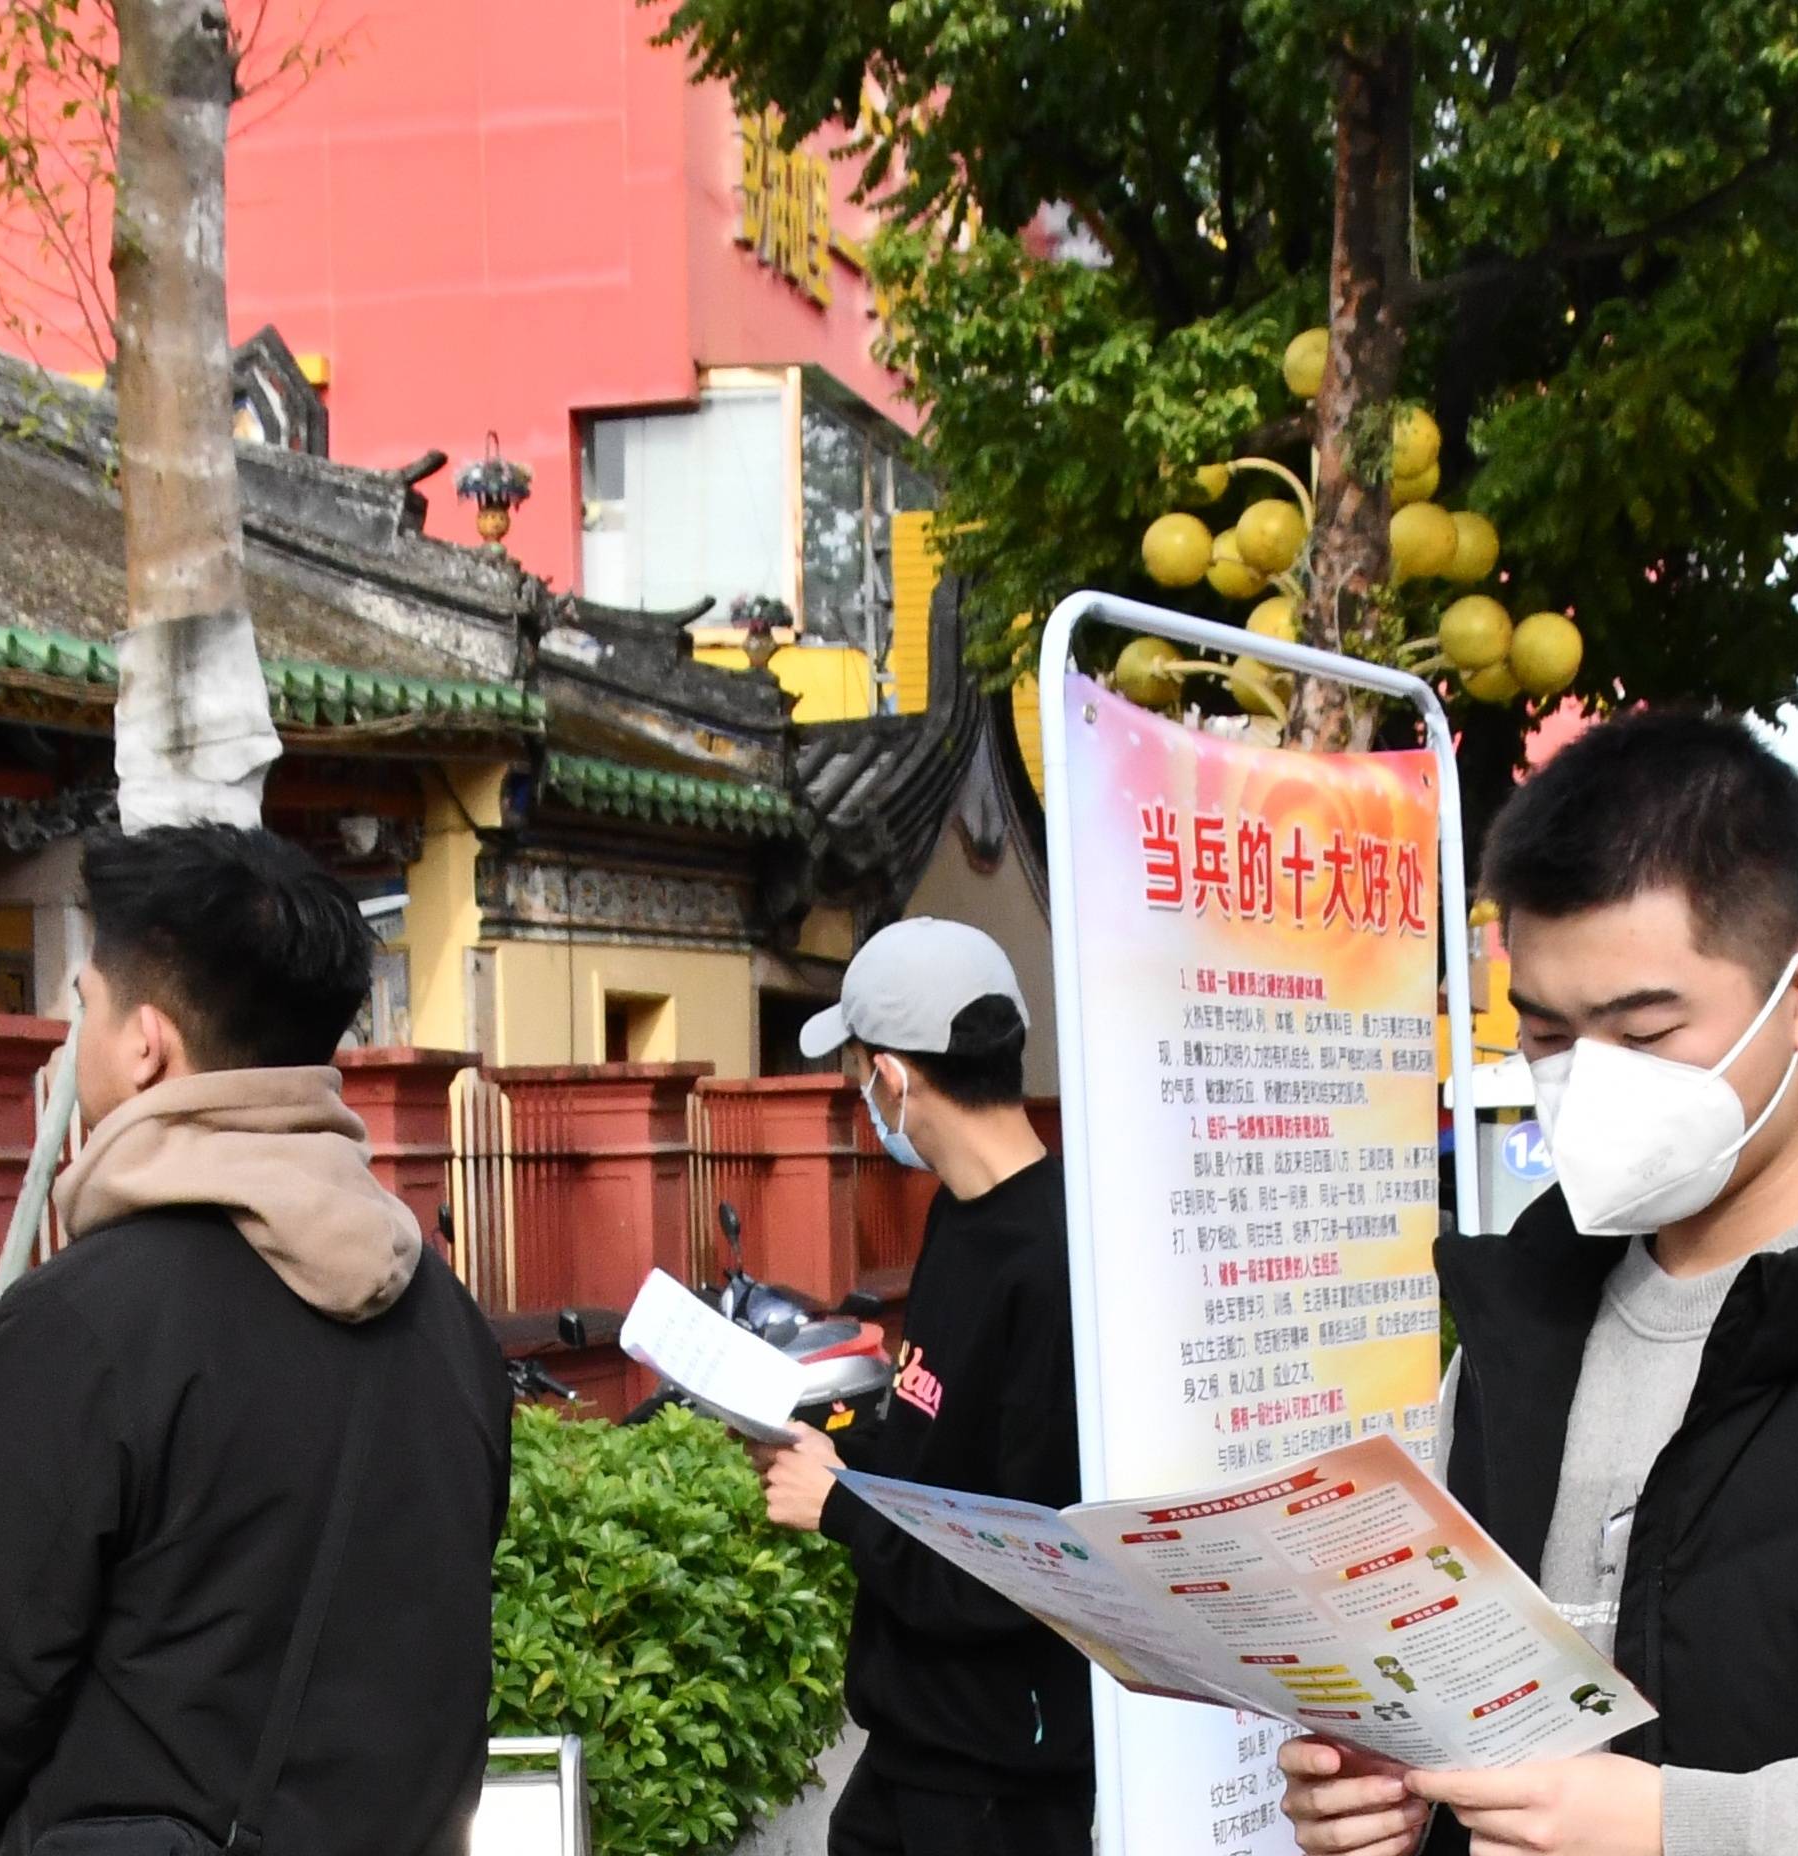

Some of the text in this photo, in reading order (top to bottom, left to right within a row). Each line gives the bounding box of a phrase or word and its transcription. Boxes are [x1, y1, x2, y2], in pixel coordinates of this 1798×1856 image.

[1142, 806, 1426, 931] 当兵的十大好处
